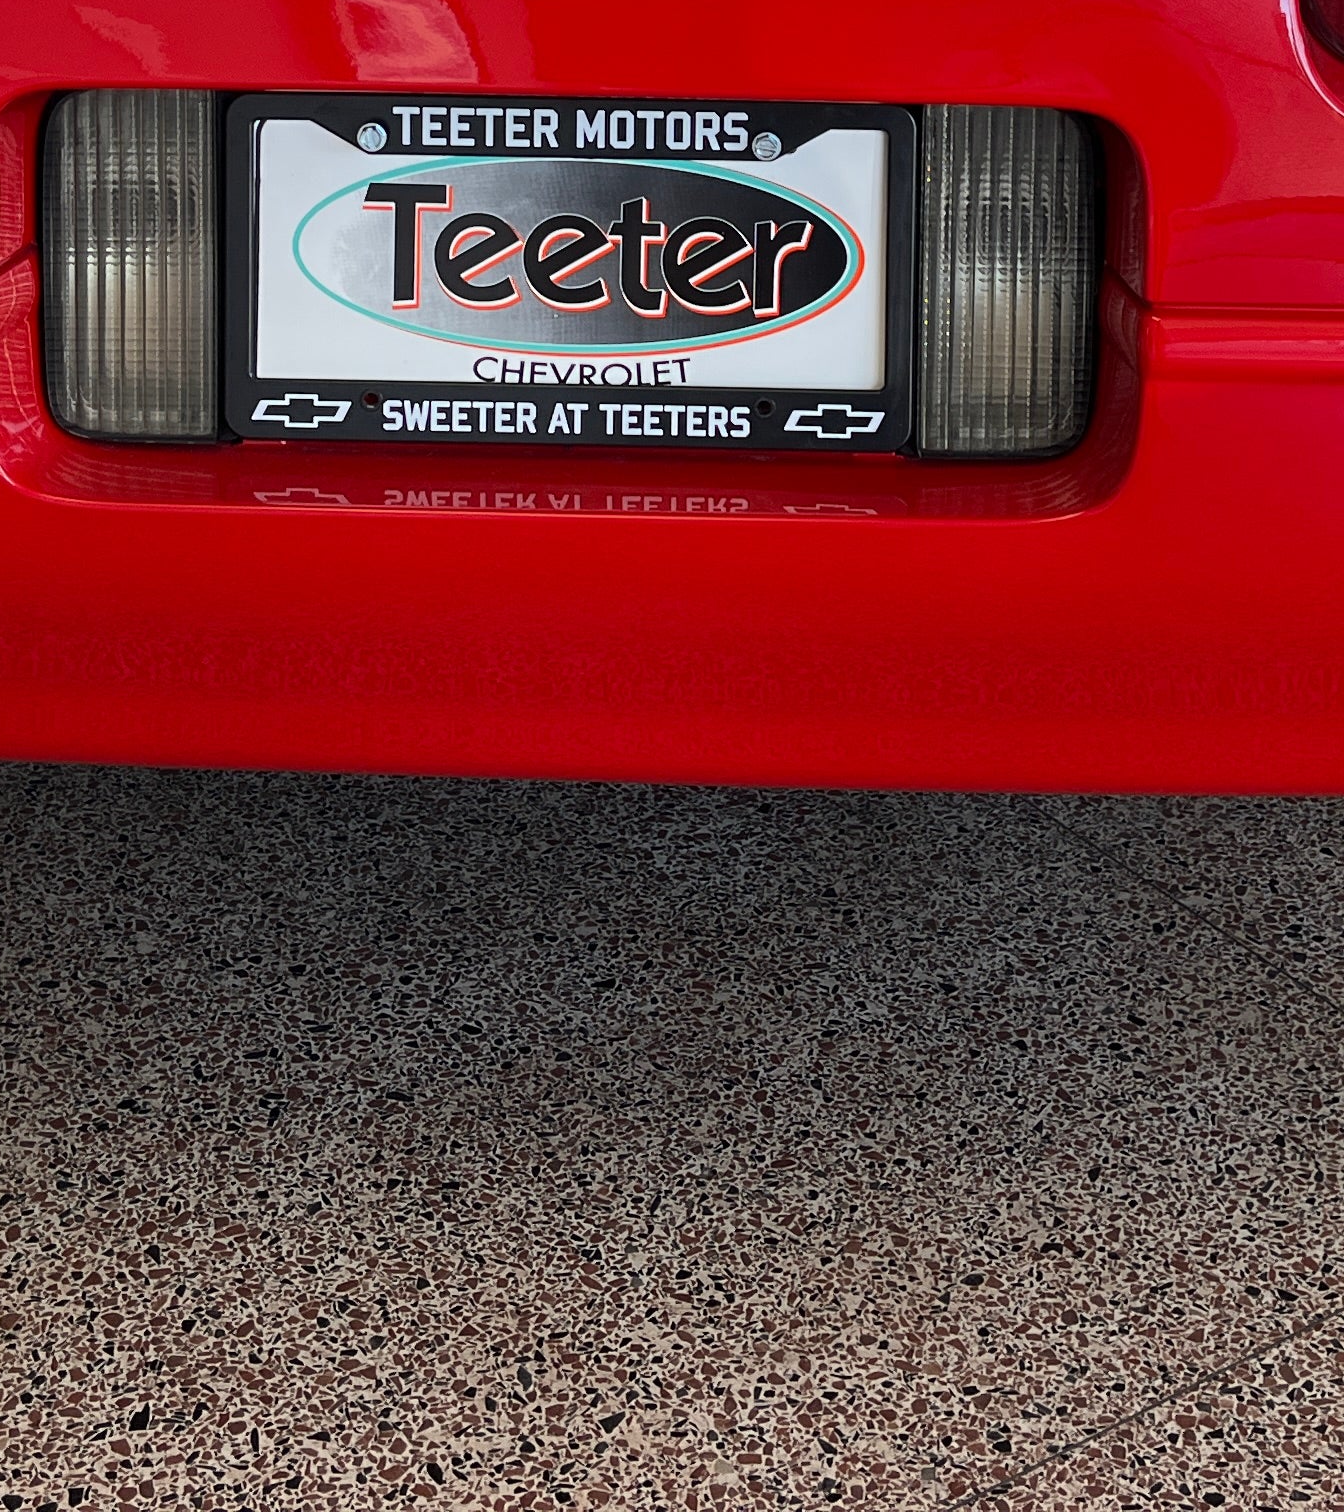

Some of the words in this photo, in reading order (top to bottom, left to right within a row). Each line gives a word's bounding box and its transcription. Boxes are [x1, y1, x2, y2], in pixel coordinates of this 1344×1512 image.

[392, 106, 559, 148] TEETER
[575, 109, 749, 152] MOTORS
[362, 182, 813, 317] Teeter
[472, 356, 691, 387] CHEVROLET
[382, 399, 537, 434] SWEETER
[547, 402, 589, 435] AT
[598, 403, 751, 438] TEETERS
